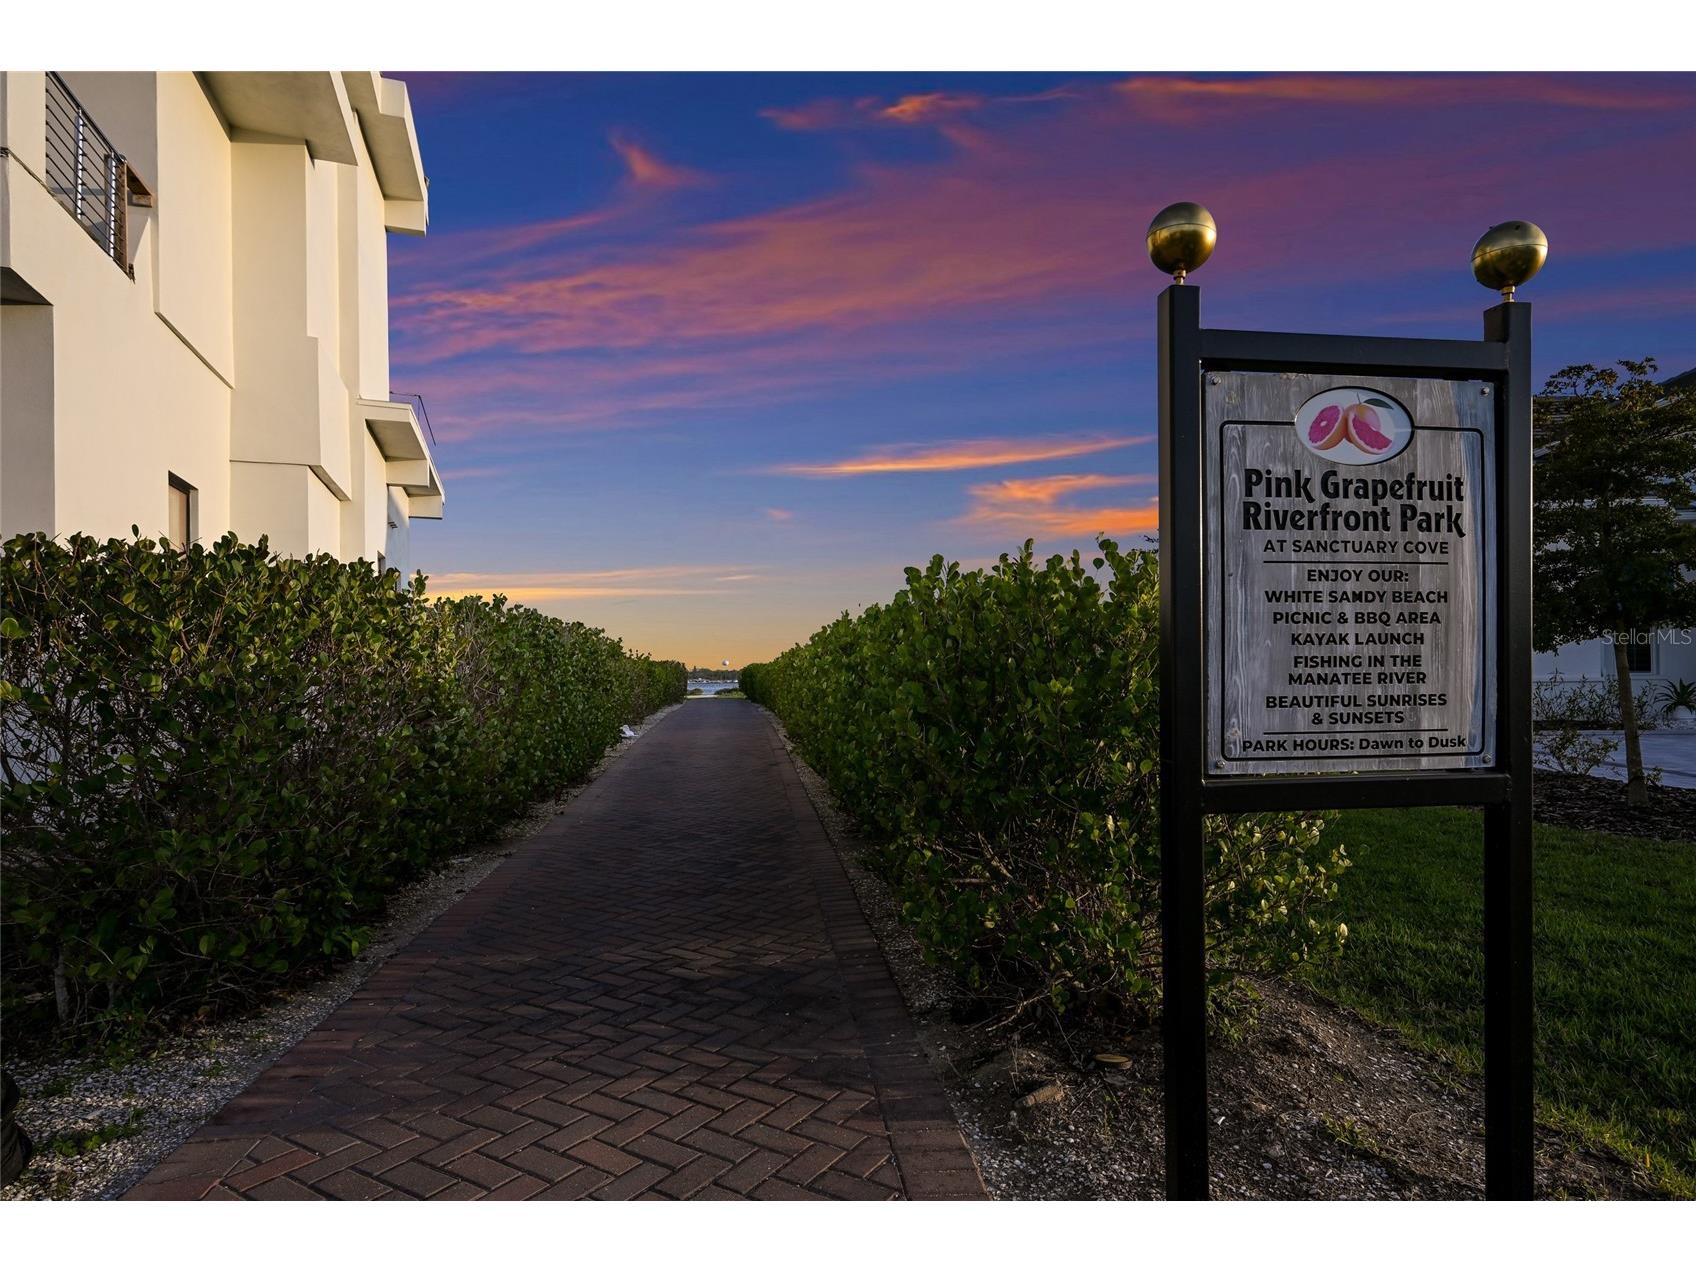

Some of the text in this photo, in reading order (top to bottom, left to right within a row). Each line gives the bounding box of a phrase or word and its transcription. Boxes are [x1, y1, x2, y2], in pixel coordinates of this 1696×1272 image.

[1244, 469, 1464, 507] Pink Grapefruit
[1243, 502, 1466, 538] Riverfront Park
[1264, 540, 1448, 554] AT SANCTUARY COVE
[1307, 569, 1409, 582] ENJOY OUR:
[1264, 591, 1448, 603] WHITE SANDY BEACH
[1273, 612, 1440, 625] PICNIC & BBQ AREA
[1292, 633, 1424, 645] KAYAK LAUNCH
[1294, 655, 1422, 668] FISHING IN THE
[1288, 672, 1426, 685] MANATEE RIVER
[1266, 694, 1447, 708] BEAUTIFUL SUNRISES
[1312, 711, 1405, 724] & SUNSETS
[1243, 736, 1466, 751] PARK HOURS: Dawn to Dusk
